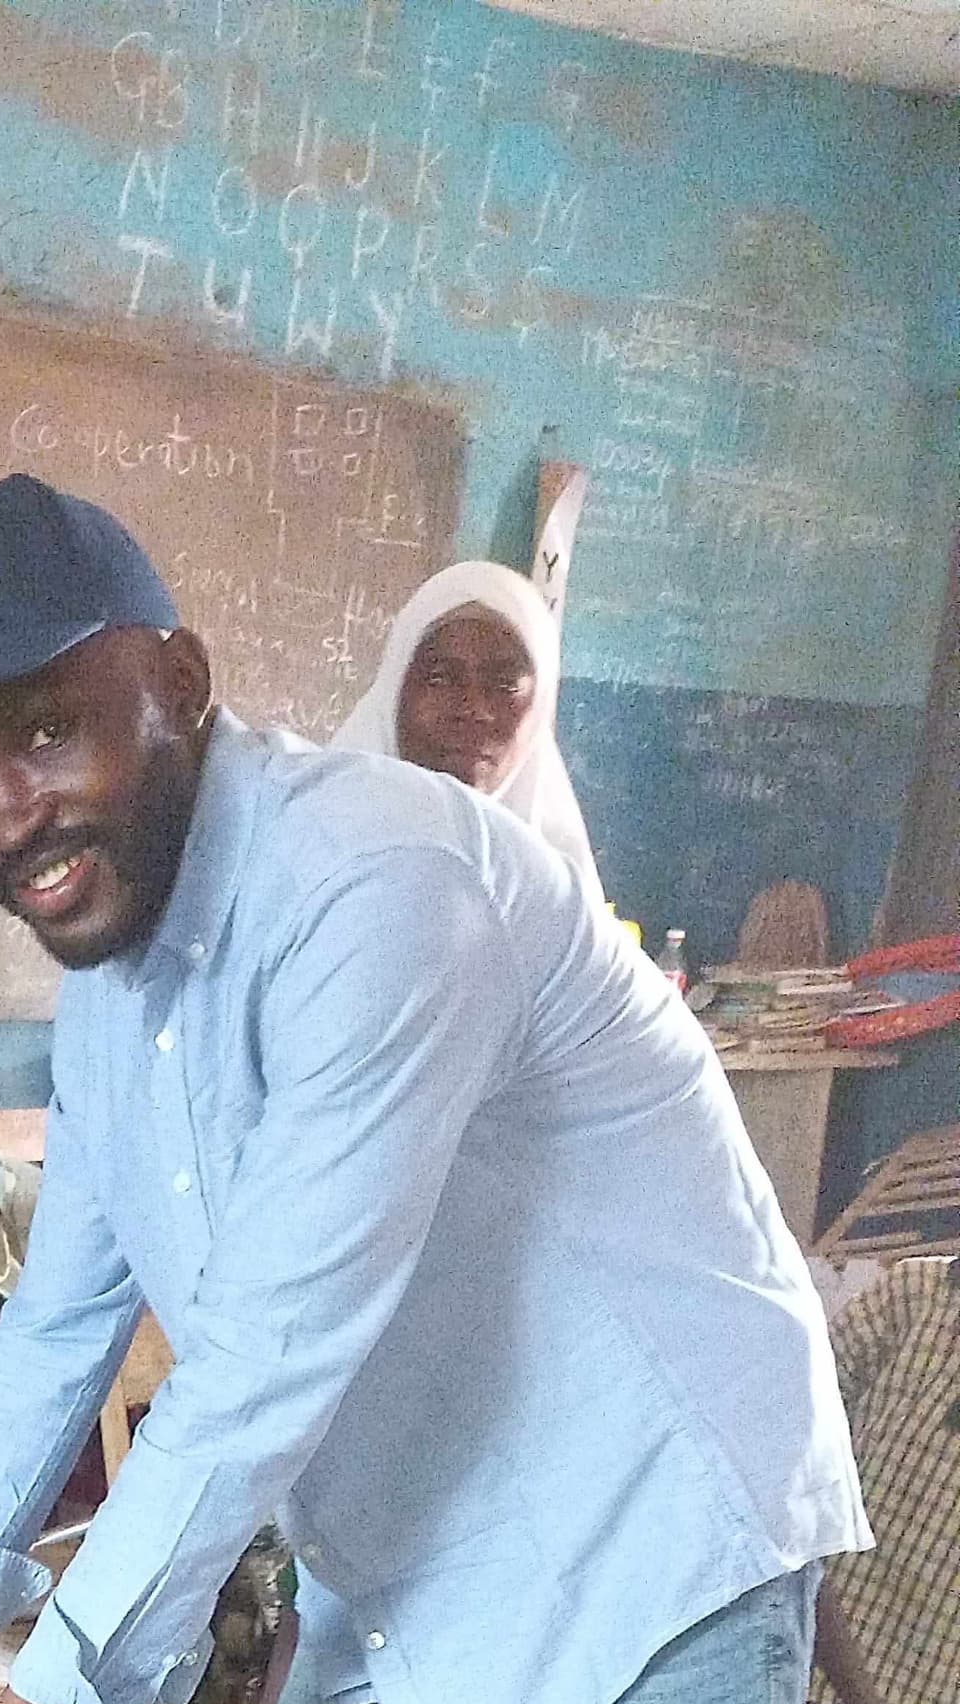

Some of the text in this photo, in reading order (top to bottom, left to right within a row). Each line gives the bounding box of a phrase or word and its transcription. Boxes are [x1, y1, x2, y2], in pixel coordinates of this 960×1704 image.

[117, 143, 174, 221] N
[212, 164, 258, 236] O
[350, 205, 392, 281] P
[344, 121, 378, 191] J
[414, 126, 451, 211] K
[477, 138, 511, 238] L
[117, 233, 174, 320] T
[285, 279, 338, 356] W
[367, 288, 405, 381] Y
